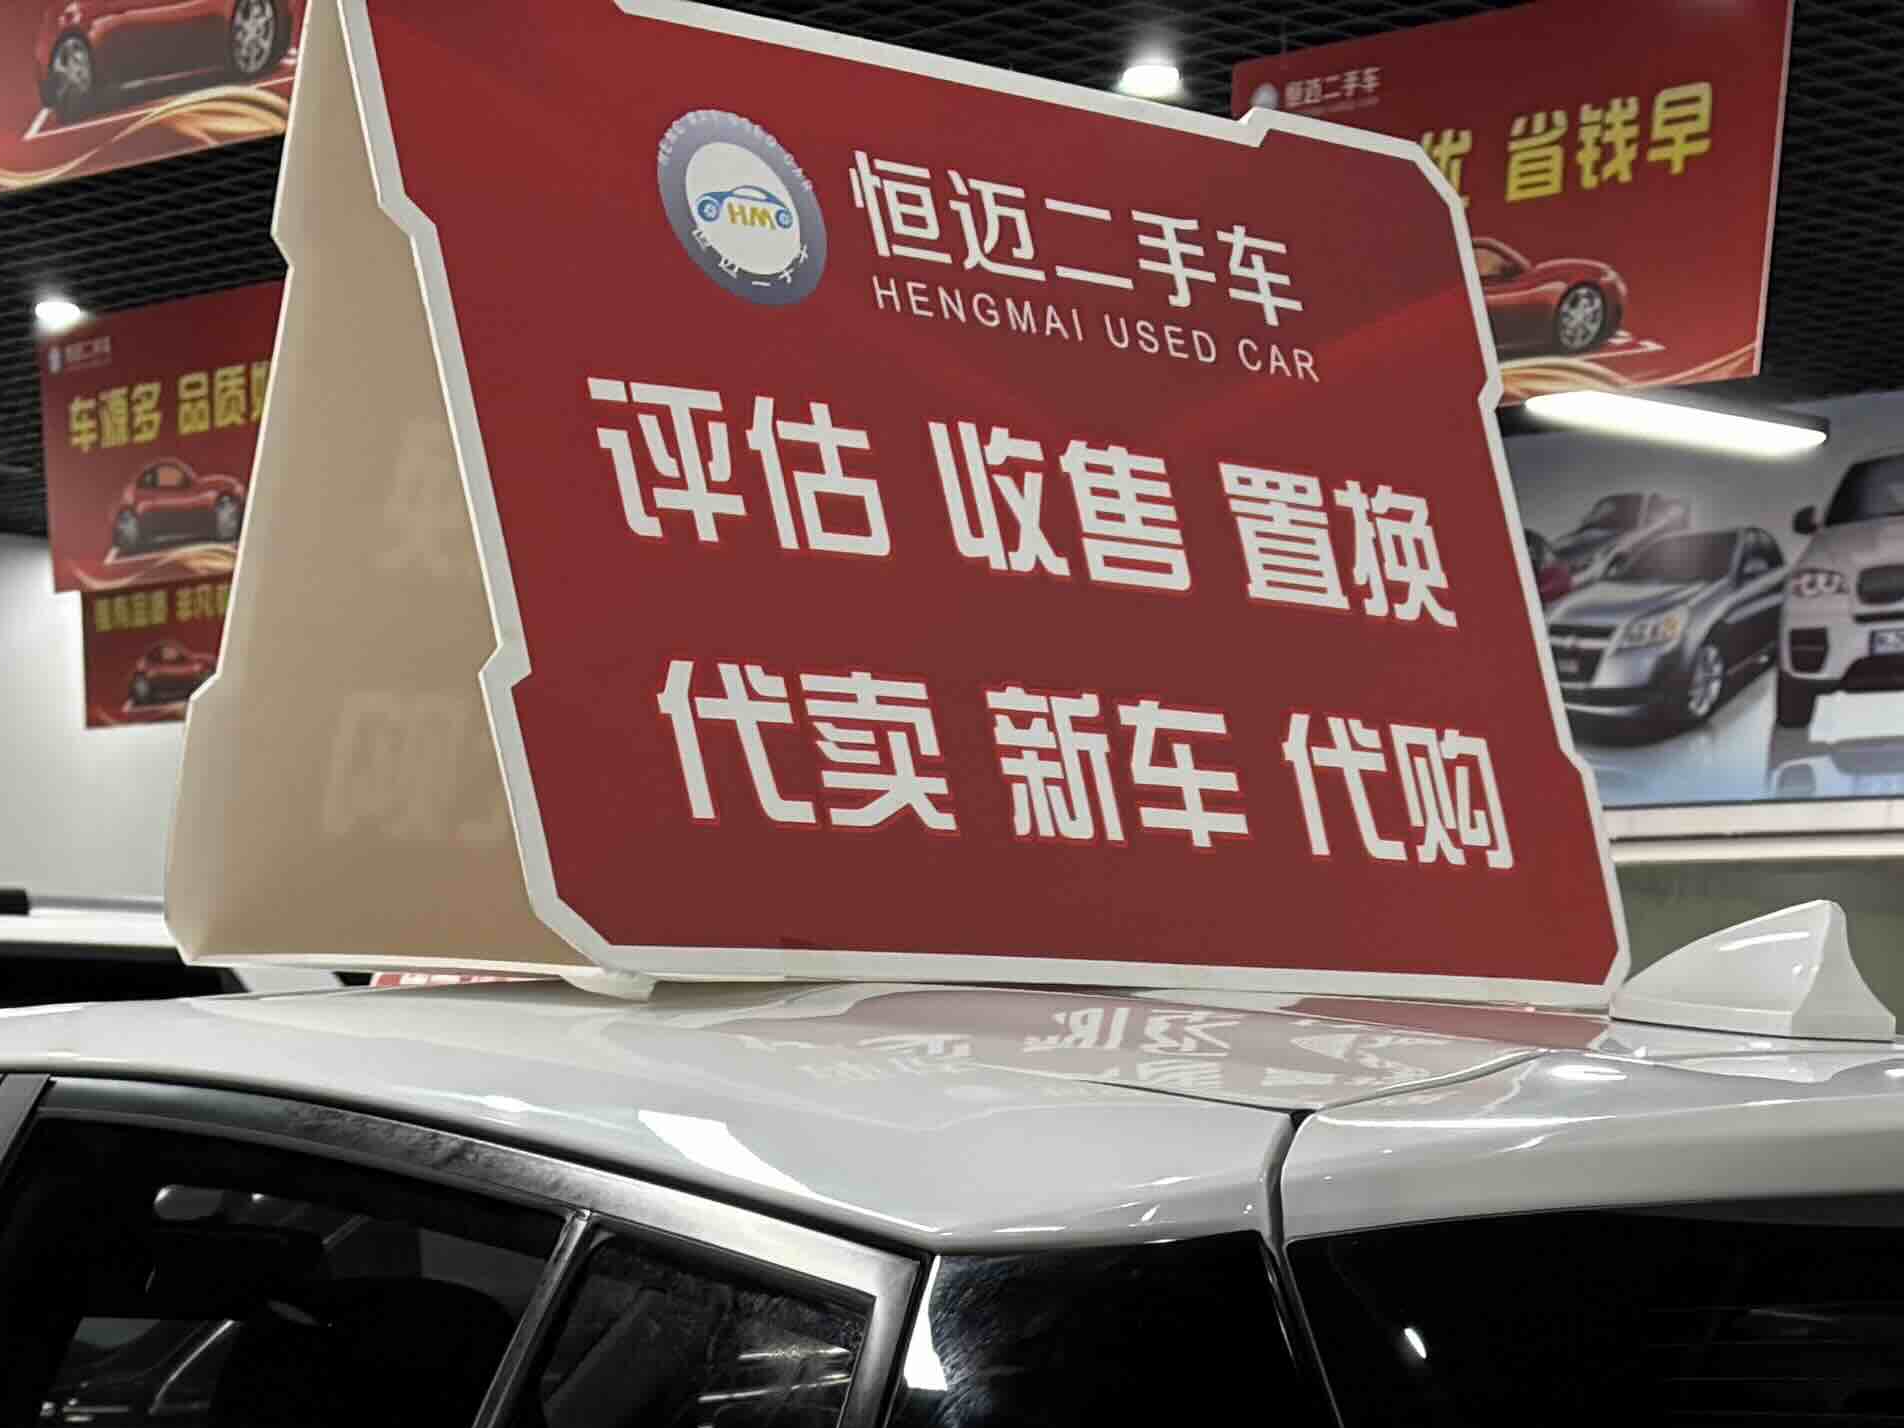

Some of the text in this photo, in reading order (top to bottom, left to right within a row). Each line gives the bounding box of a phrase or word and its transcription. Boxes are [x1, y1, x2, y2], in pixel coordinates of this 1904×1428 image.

[1505, 81, 1713, 204] 省钱早
[848, 150, 1304, 328] 恒迈二手车
[871, 274, 1320, 384] HENGMAI USED CAR
[68, 381, 162, 454] 车源多
[587, 376, 1459, 628] 评估 收售 置换
[656, 660, 1515, 870] 代卖 新车 代购
